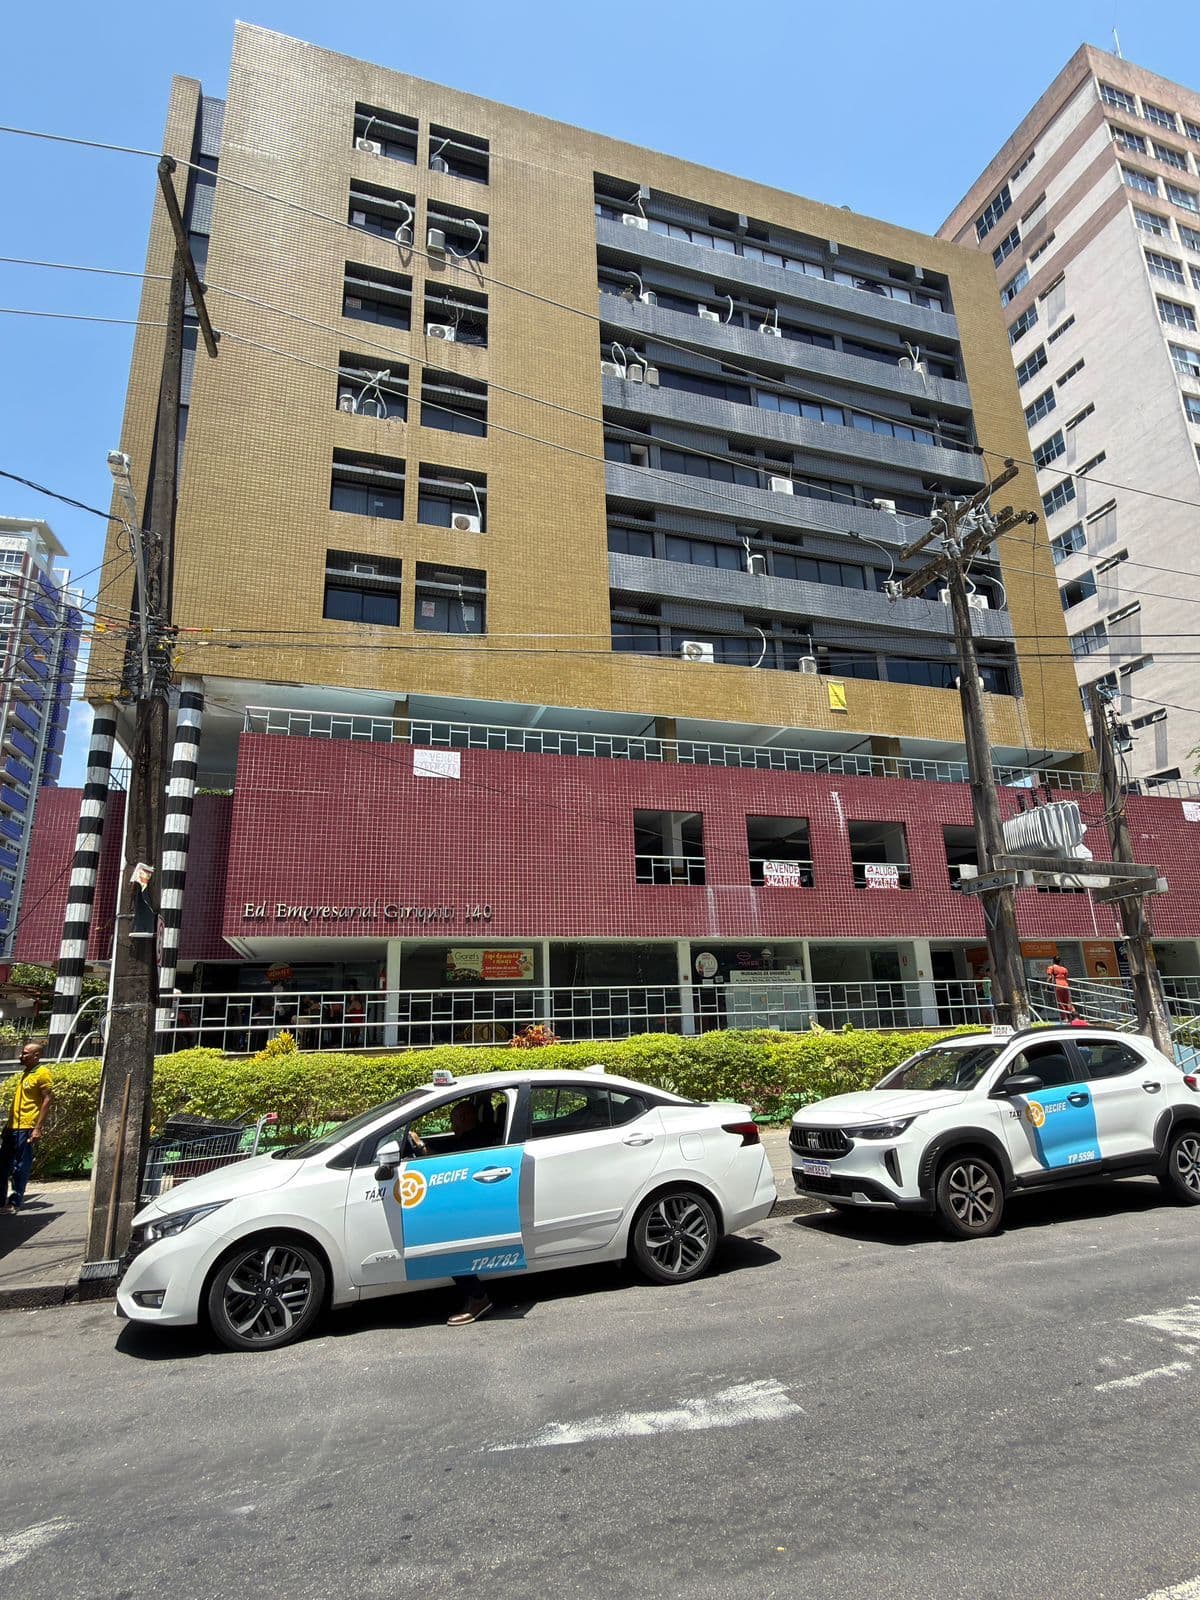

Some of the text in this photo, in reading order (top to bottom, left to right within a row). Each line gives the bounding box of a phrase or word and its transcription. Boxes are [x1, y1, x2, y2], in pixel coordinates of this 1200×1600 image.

[773, 863, 800, 874] VENDE
[875, 866, 899, 877] ALUGA
[275, 898, 379, 922] Empresarial
[383, 903, 457, 923] Giriquiti
[464, 903, 493, 919] 140
[1044, 1102, 1067, 1113] RECIFE
[428, 1168, 469, 1186] RECIFE
[470, 1253, 519, 1271] TP4783
